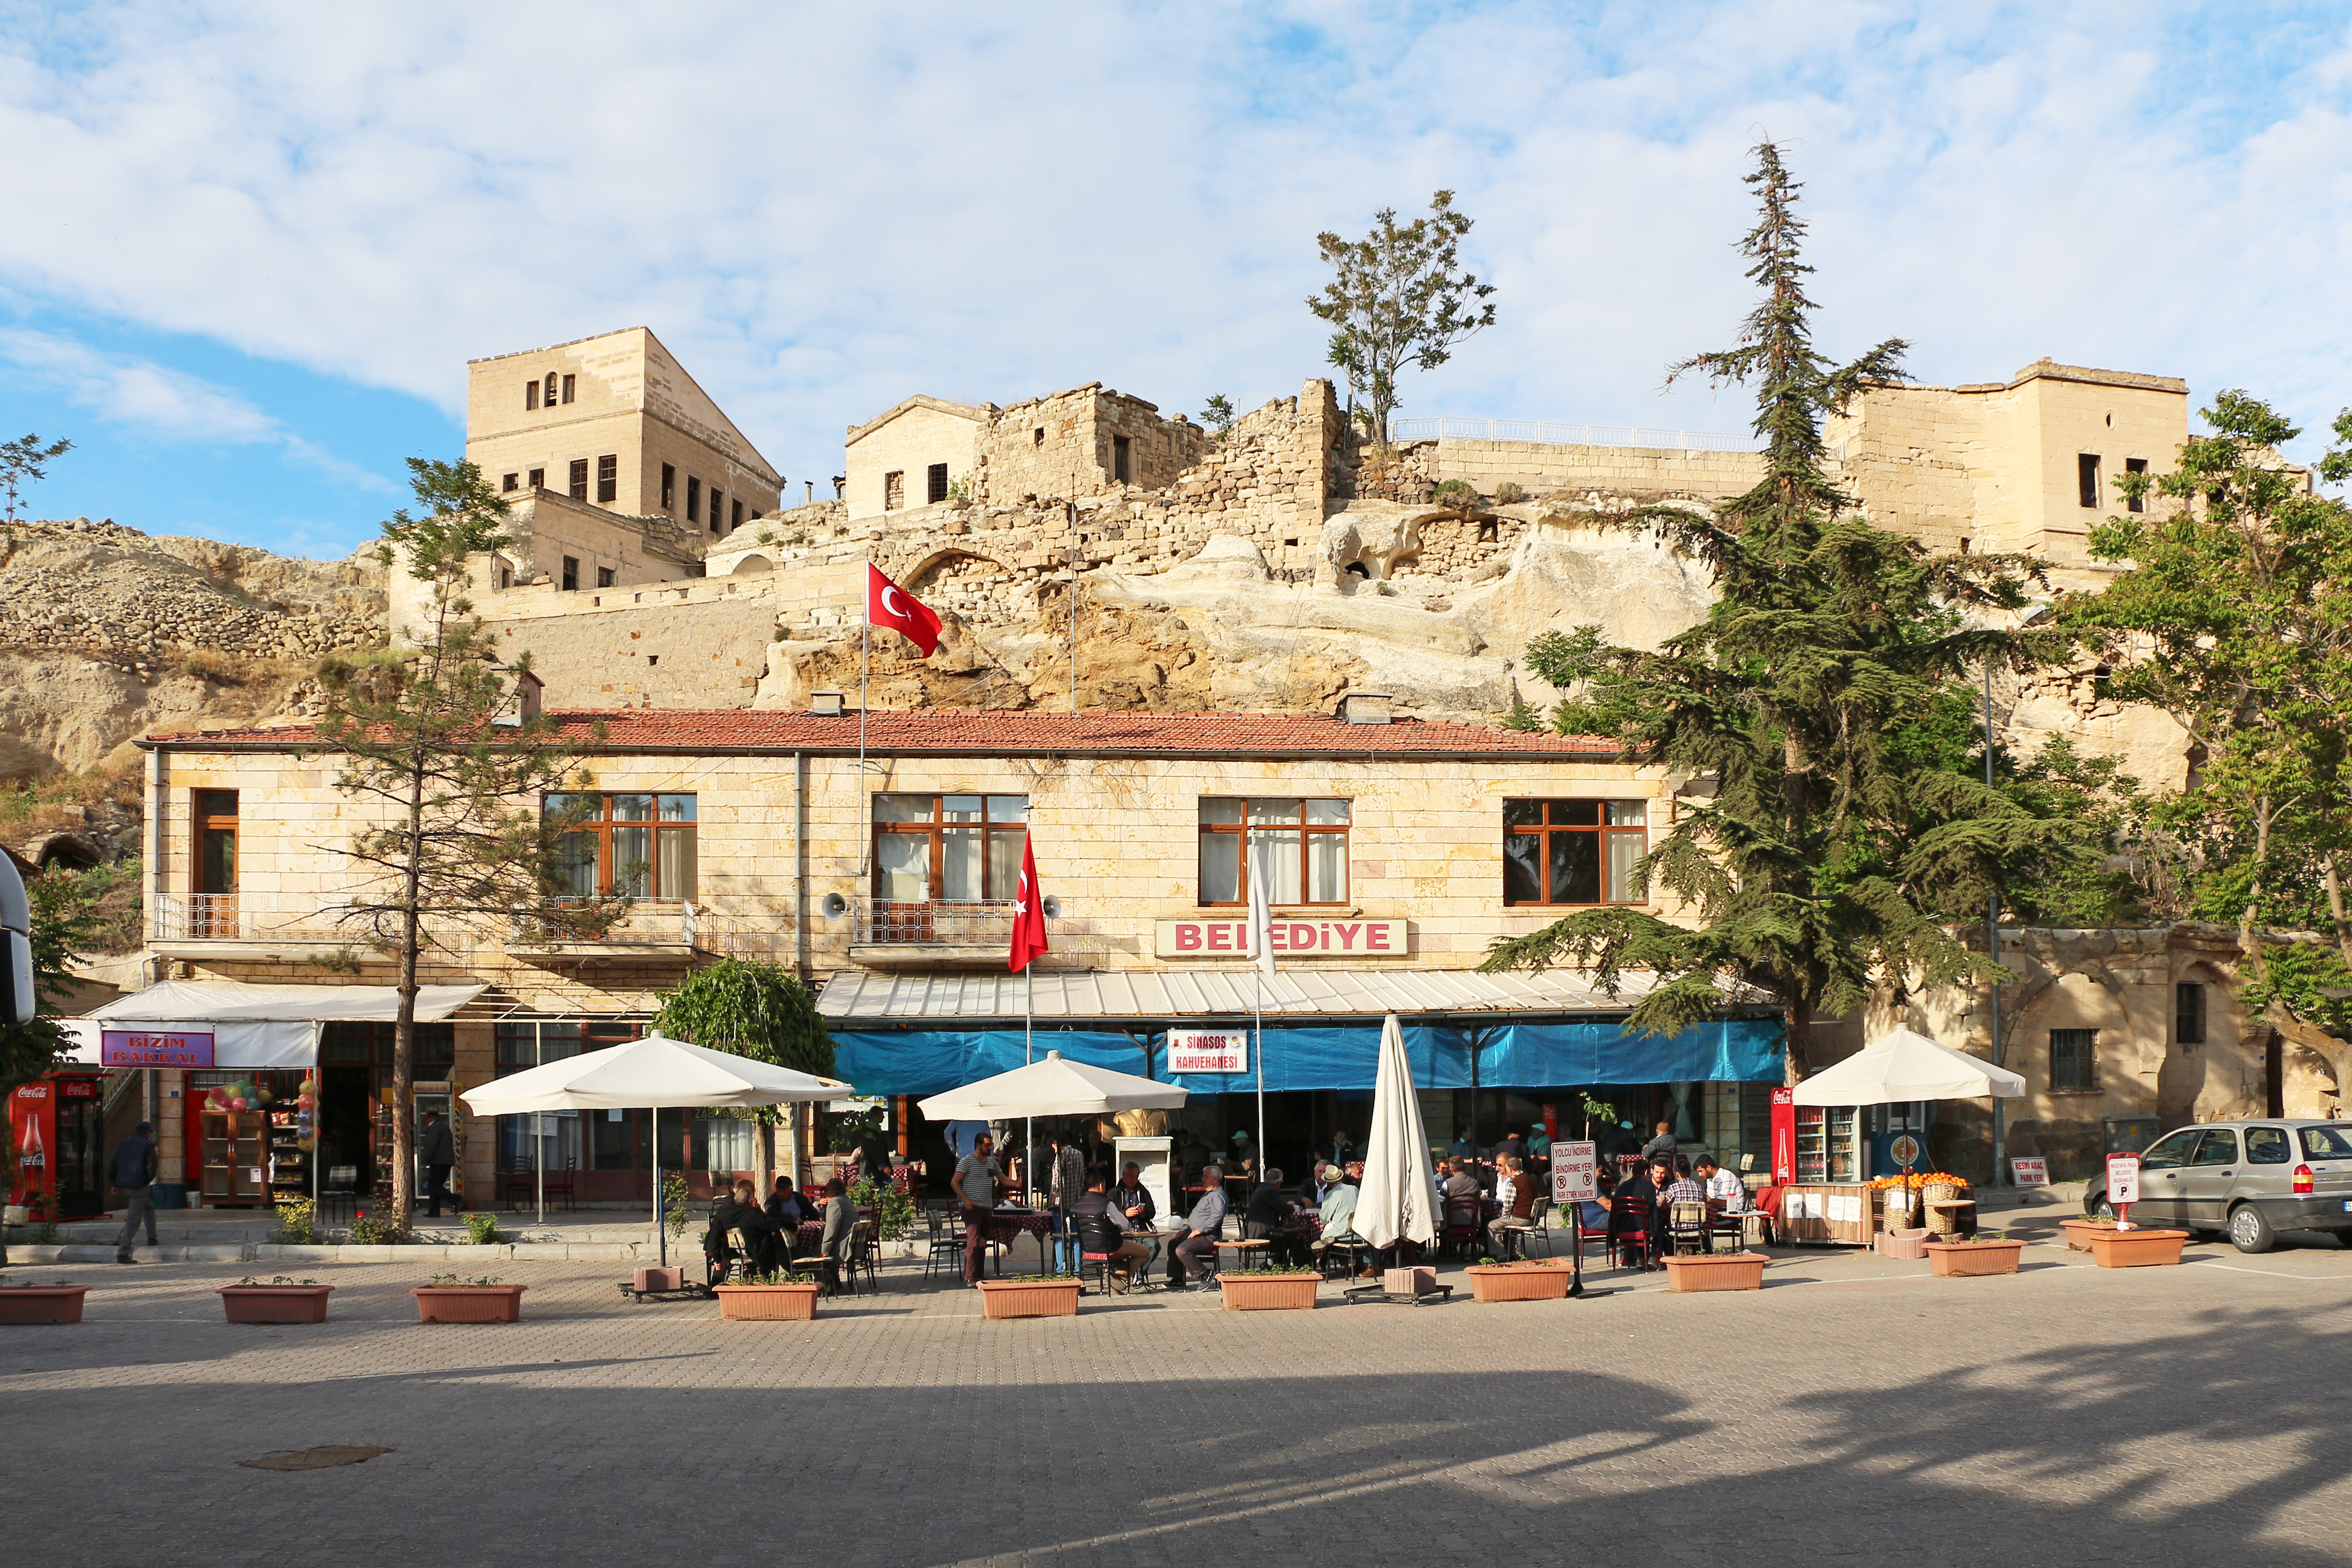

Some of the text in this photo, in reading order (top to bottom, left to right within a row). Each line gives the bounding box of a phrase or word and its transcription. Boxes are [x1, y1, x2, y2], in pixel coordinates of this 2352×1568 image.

[128, 1034, 186, 1049] BİZİM
[1187, 1033, 1226, 1049] SİNASOS
[111, 1051, 201, 1064] BAKKAL
[1176, 1053, 1238, 1069] KAHVEHANESİ
[18, 1087, 47, 1098] Coca-Cola
[1555, 1146, 1592, 1157] YOLCU İNDİRME
[1556, 1160, 1593, 1174] BİNDİRME YERİ
[2031, 1162, 2043, 1170] ARAÇ
[2033, 1173, 2044, 1182] YERİ
